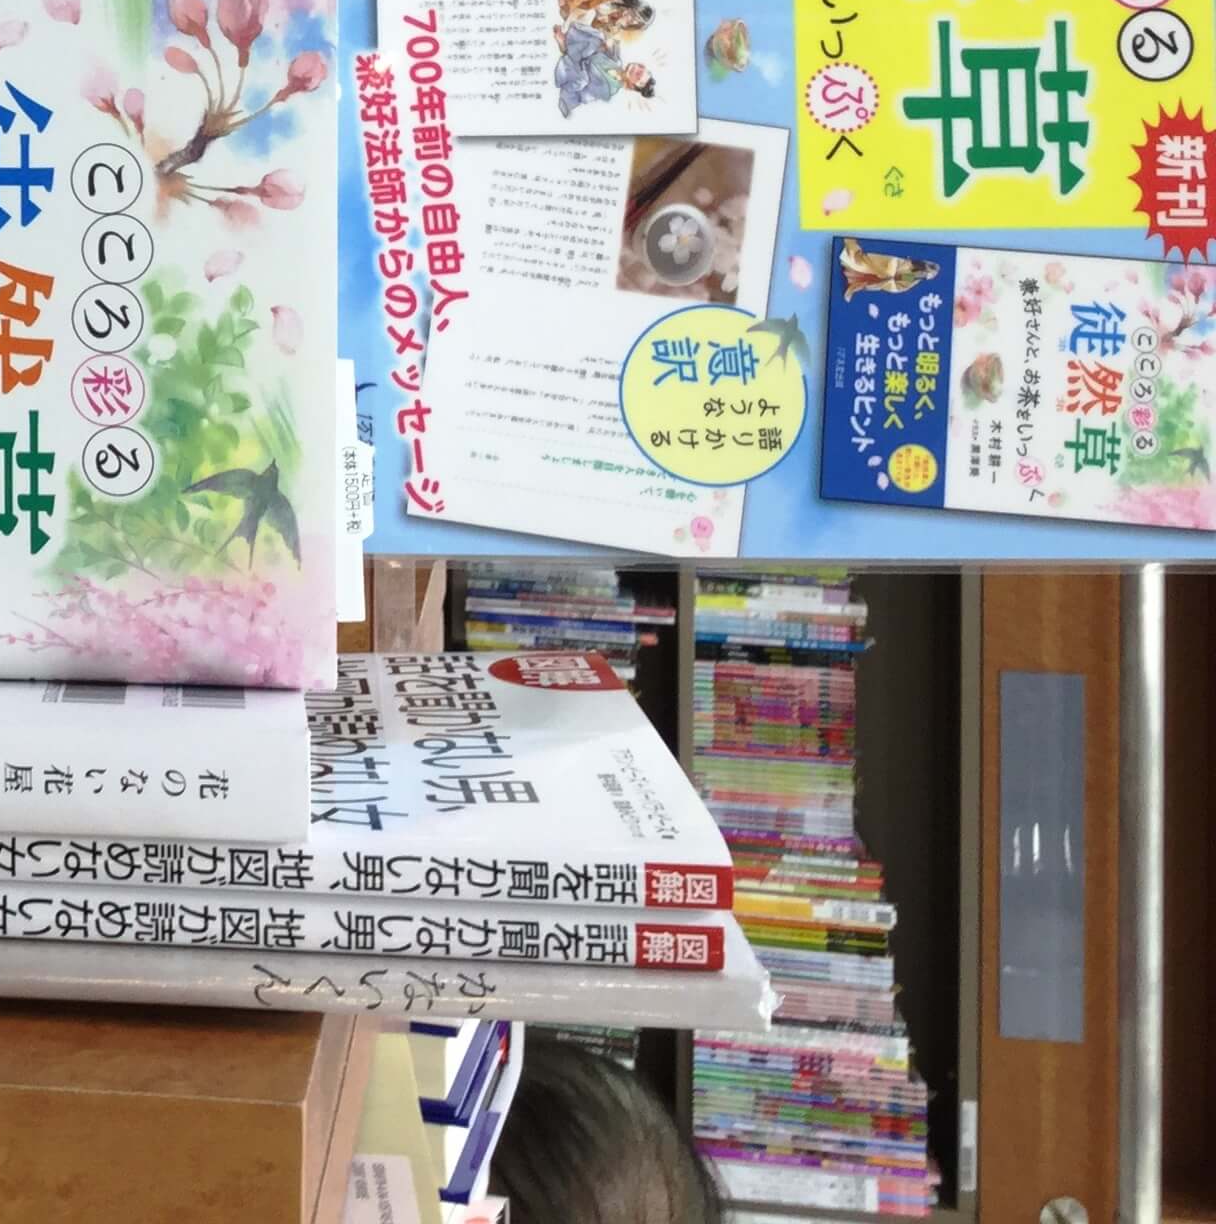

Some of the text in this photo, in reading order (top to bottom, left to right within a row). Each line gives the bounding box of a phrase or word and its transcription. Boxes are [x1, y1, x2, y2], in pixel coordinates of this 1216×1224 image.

[405, 9, 469, 334] 700年前の自由人、
[884, 166, 904, 200] ぐさ
[1156, 135, 1207, 227] 新刊
[79, 158, 143, 482] こころ彩る
[355, 55, 446, 514] 兼好法師からのメッセージ
[650, 336, 761, 387] 意訳
[703, 397, 780, 418] ような
[850, 333, 881, 453] 生きるヒント
[884, 312, 912, 429] もっと楽しく
[913, 292, 942, 421] もっと明るく、
[1064, 301, 1127, 476] 徒然草
[650, 426, 783, 452] 語りかける
[2, 762, 229, 801] 花のない花屋
[306, 659, 410, 832] が読めない女
[383, 655, 541, 813] 話を聞かない男、
[650, 868, 718, 906] 図解
[252, 965, 496, 1016] かないくん
[642, 929, 709, 965] 図解
